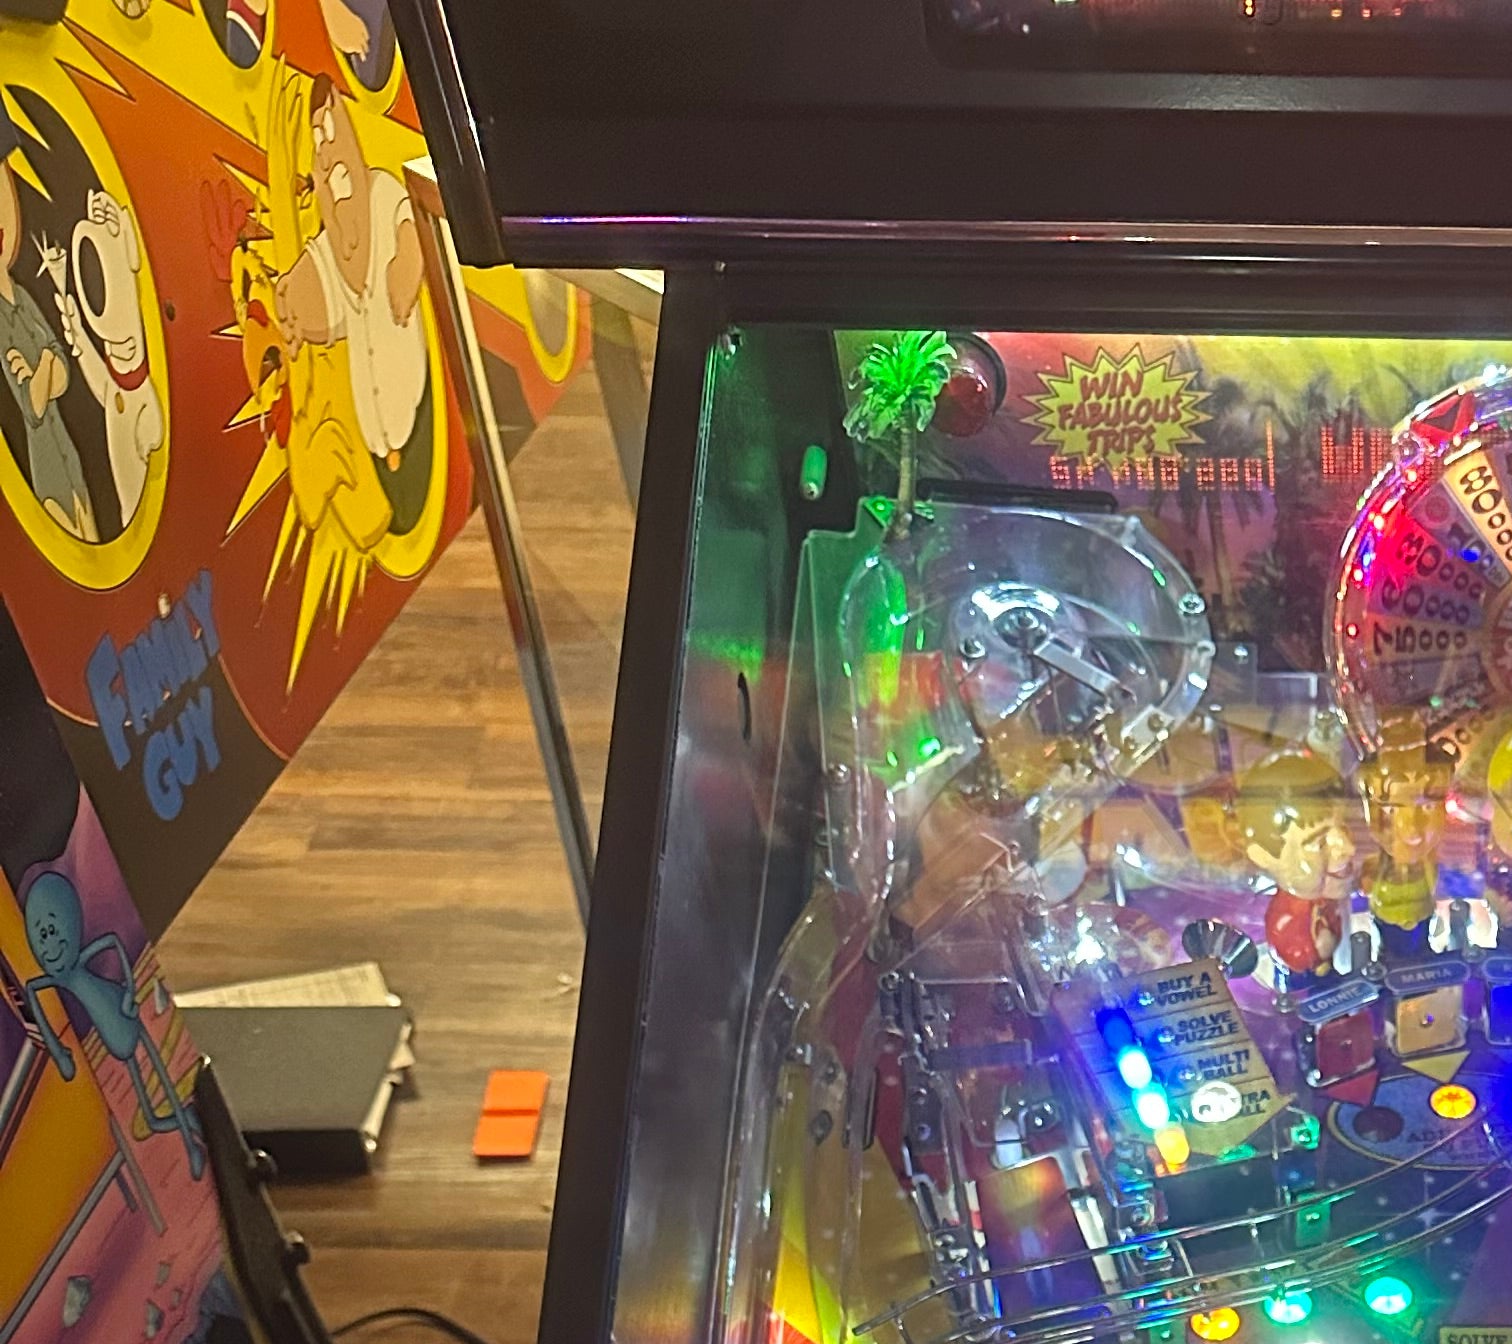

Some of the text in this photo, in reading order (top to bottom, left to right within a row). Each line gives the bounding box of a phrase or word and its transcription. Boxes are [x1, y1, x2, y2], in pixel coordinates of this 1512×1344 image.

[1080, 371, 1143, 400] WIN
[1058, 395, 1182, 430] FABULOUS
[1087, 425, 1156, 455] TRIPS
[85, 568, 222, 771] FAMILY
[143, 685, 222, 821] GUY
[1157, 971, 1212, 992] BUY A
[1402, 966, 1452, 984] MARIA
[1152, 985, 1218, 1007] VOWEL
[1308, 985, 1364, 1013] LONNIE
[1176, 1009, 1233, 1031] SOLVE
[1173, 1022, 1239, 1046] PUZZLE
[1197, 1048, 1250, 1070] MULTI
[1202, 1062, 1248, 1082] BALL
